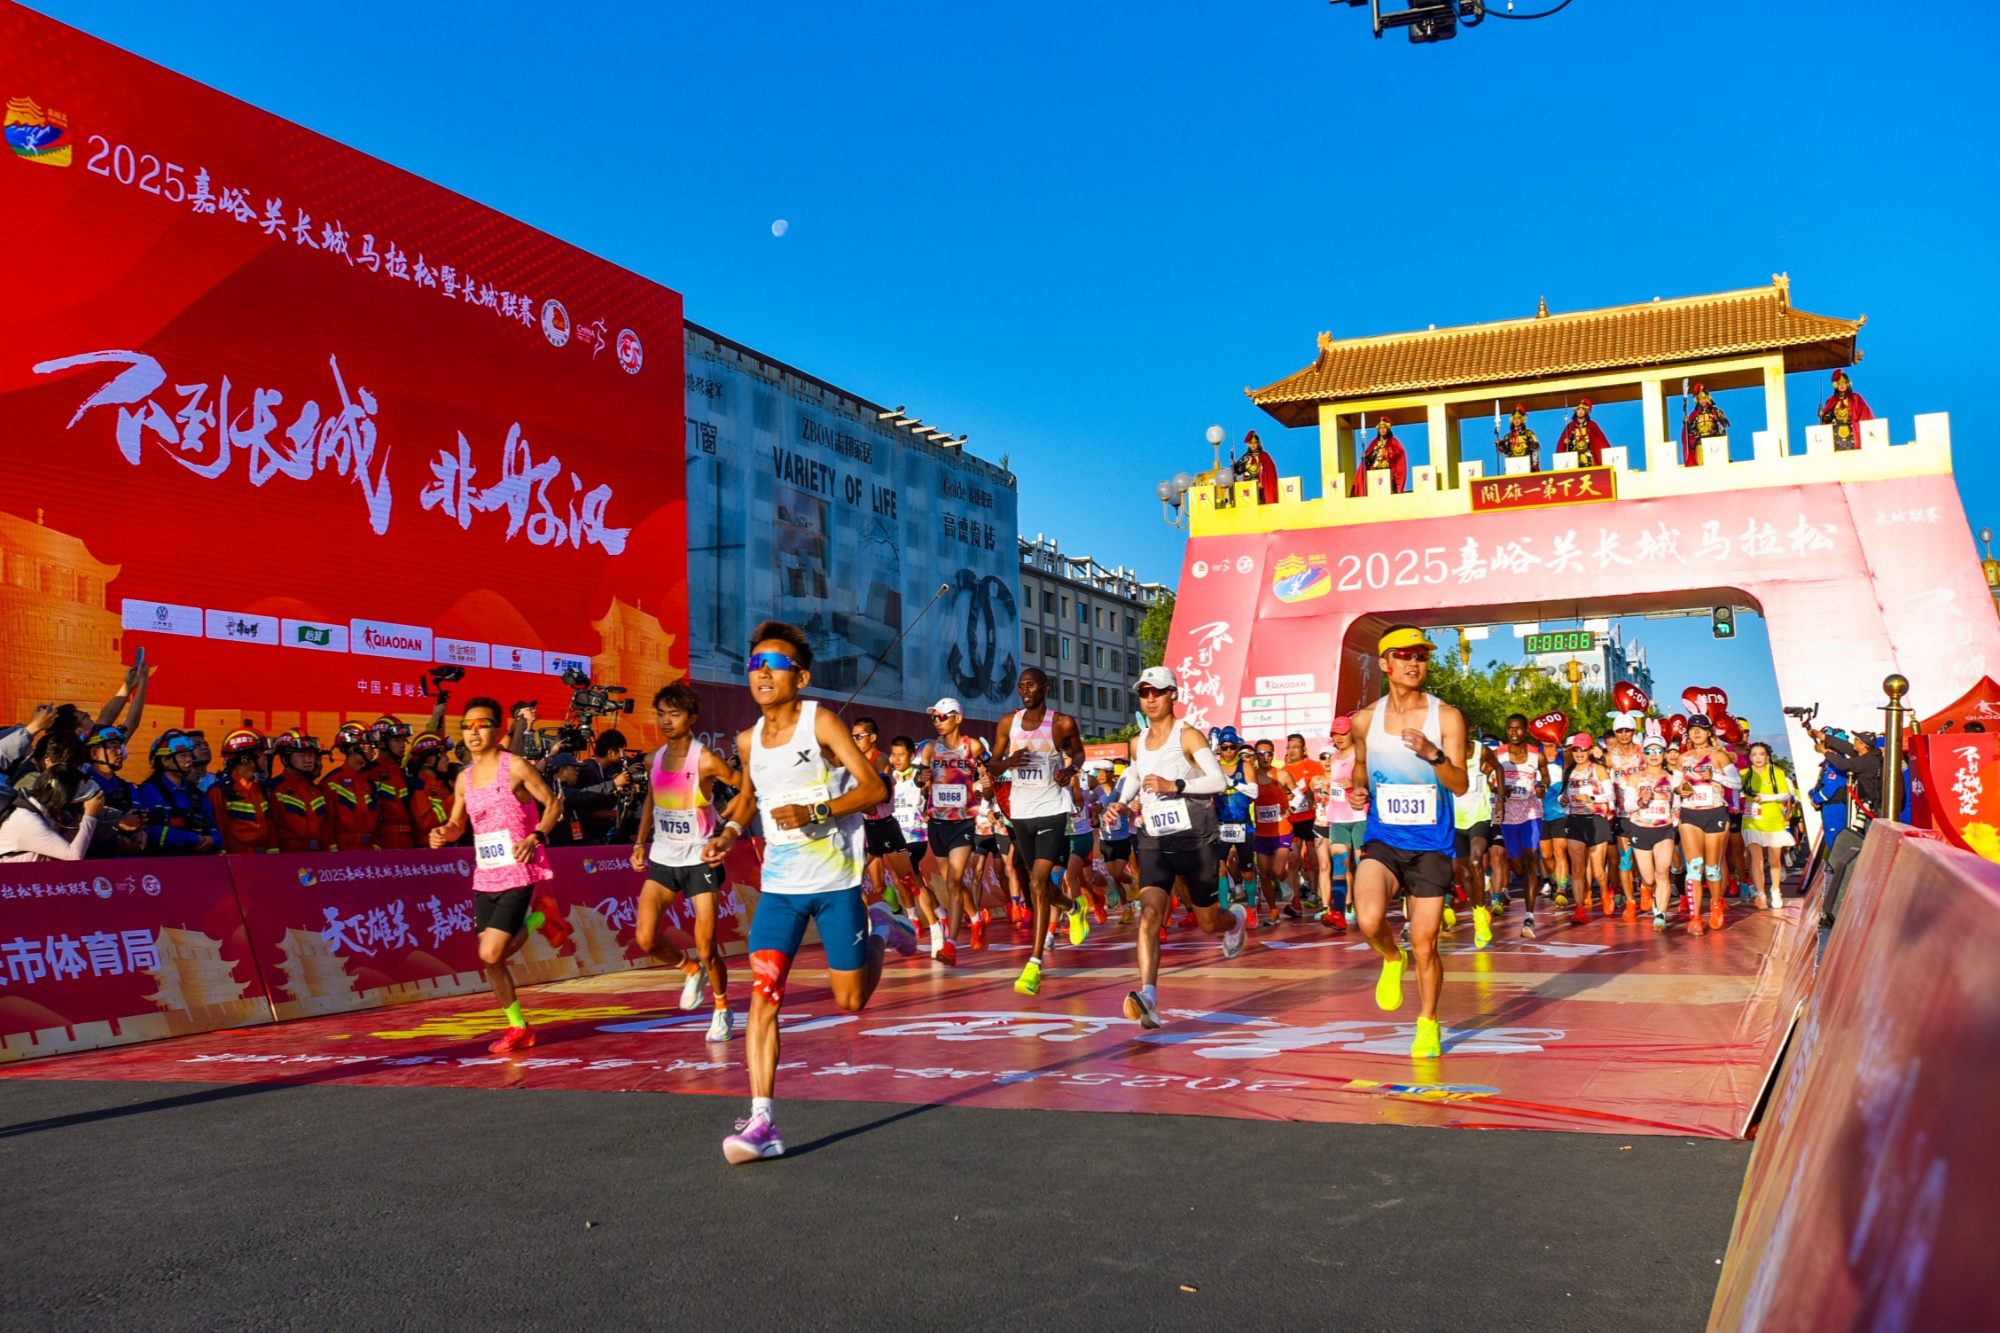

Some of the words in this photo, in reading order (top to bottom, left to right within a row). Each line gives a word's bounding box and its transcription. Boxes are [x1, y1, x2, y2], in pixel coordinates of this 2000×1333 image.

[87, 135, 536, 328] 2025嘉峪关长城马拉松暨长城联赛
[33, 349, 392, 535] 不到长城
[773, 445, 837, 498] VARIETY
[845, 474, 863, 507] OF
[872, 483, 898, 521] LIFE
[1337, 513, 1839, 592] 2025嘉峪关长城马拉松
[373, 633, 423, 651] QIAODAN
[1528, 632, 1590, 652] 0:00:06
[1271, 680, 1307, 690] QIAODAN
[1626, 688, 1648, 708] 4:00
[1534, 712, 1563, 730] 6:00
[933, 760, 971, 769] PACER
[1017, 769, 1043, 780] 10771
[938, 792, 961, 802] 10868
[1387, 799, 1426, 814] 10331
[659, 819, 691, 835] 10759
[1151, 811, 1181, 828] 10761
